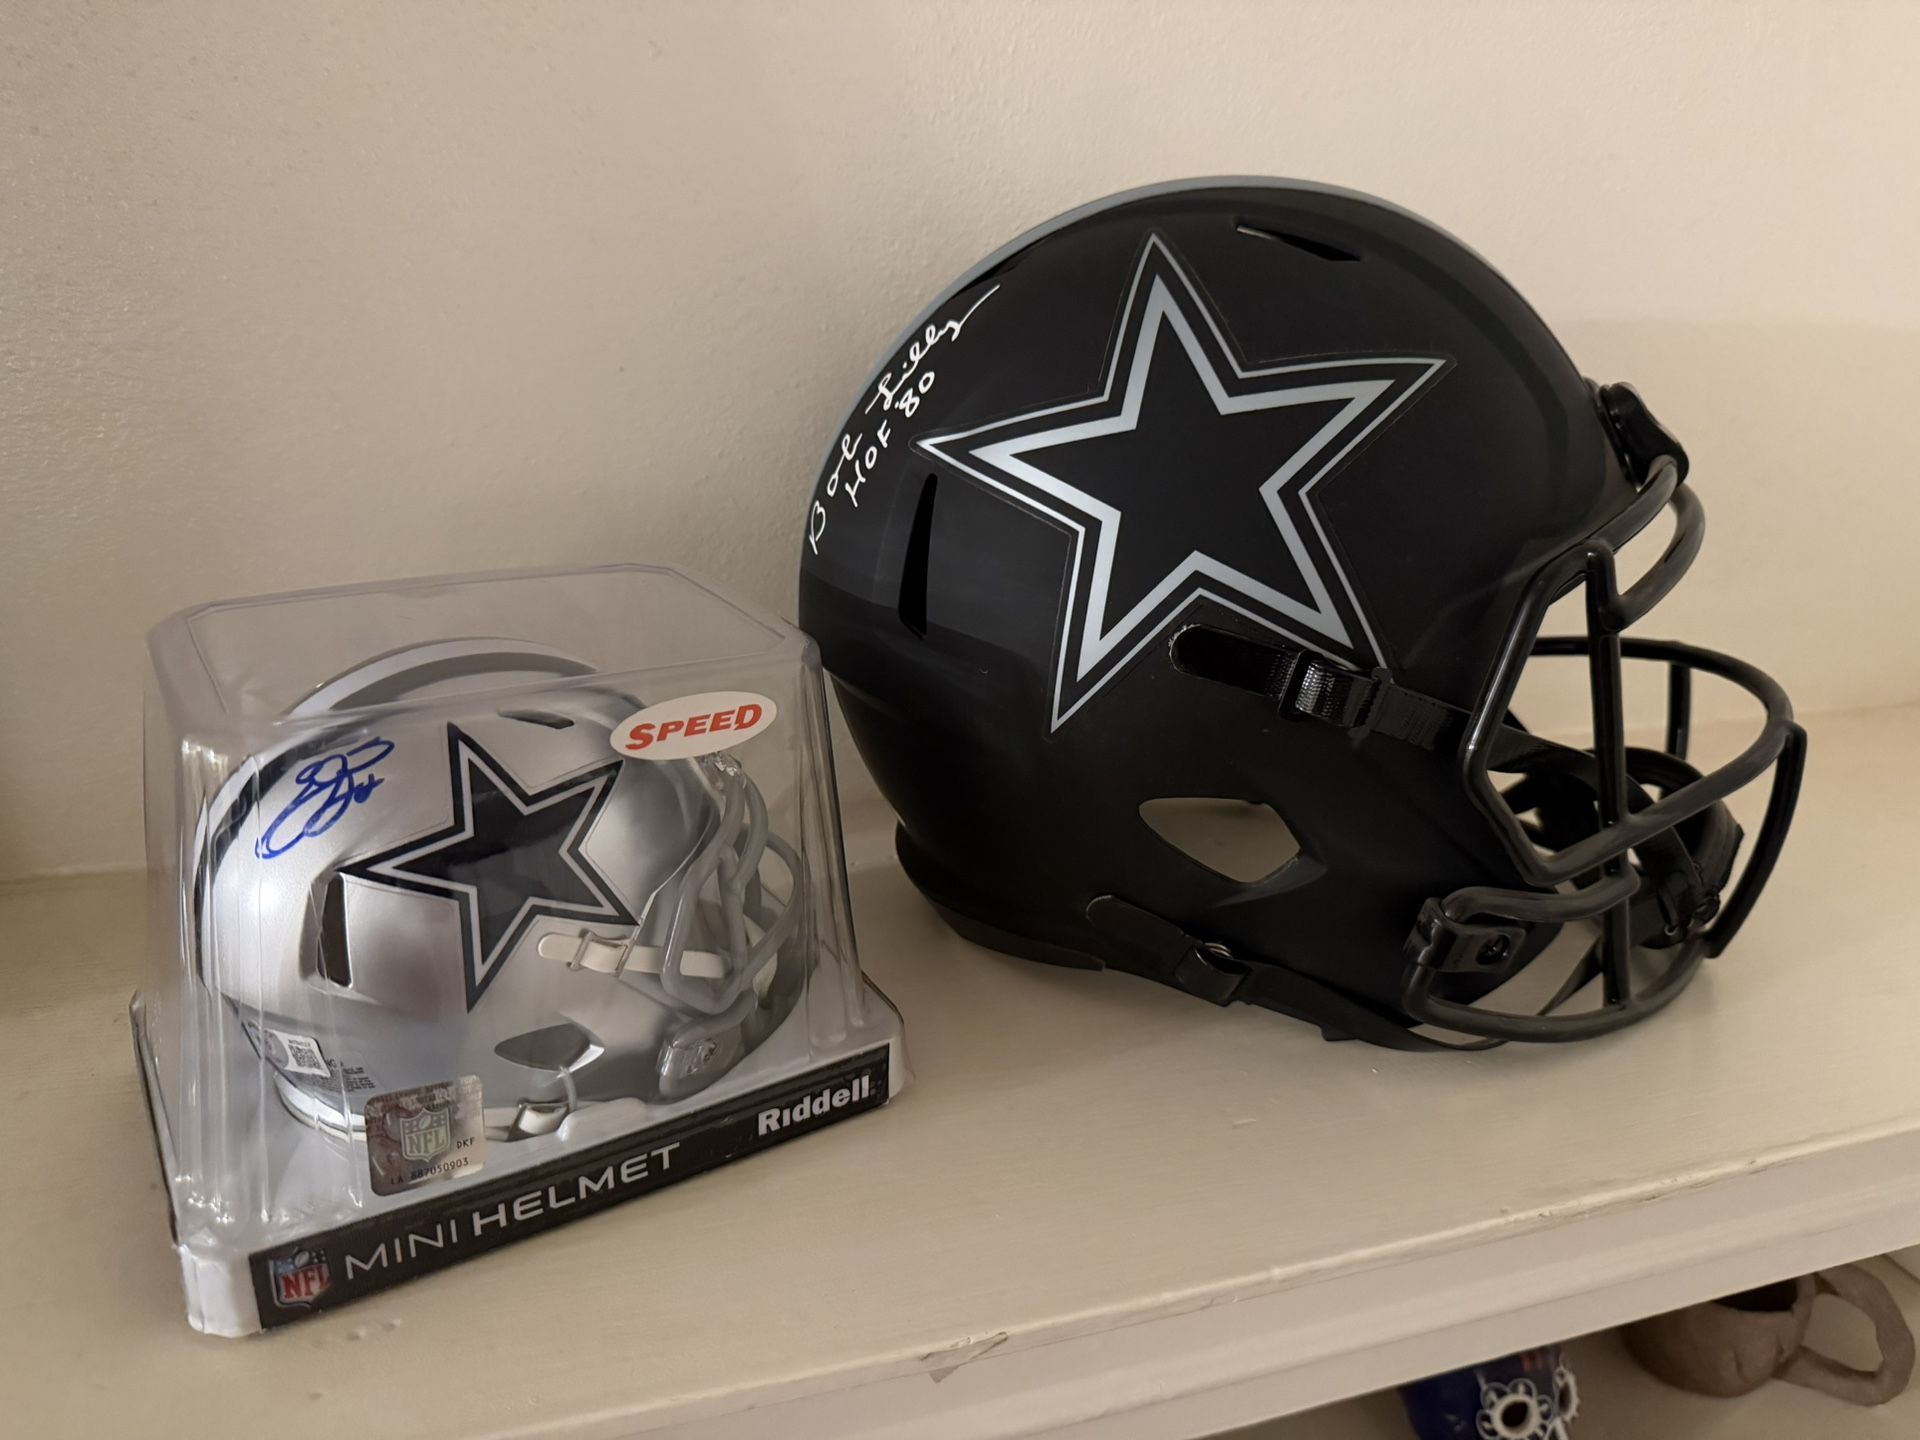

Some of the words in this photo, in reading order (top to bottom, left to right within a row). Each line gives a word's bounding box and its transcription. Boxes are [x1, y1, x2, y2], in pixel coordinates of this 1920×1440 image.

[844, 418, 892, 508] HOF
[625, 703, 763, 751] SPEED
[757, 1074, 870, 1137] Riddell
[404, 1126, 447, 1156] NFL
[455, 1136, 475, 1150] DKF
[344, 1218, 459, 1281] MINI
[471, 1141, 682, 1238] HELMET
[281, 1264, 332, 1300] NFL
